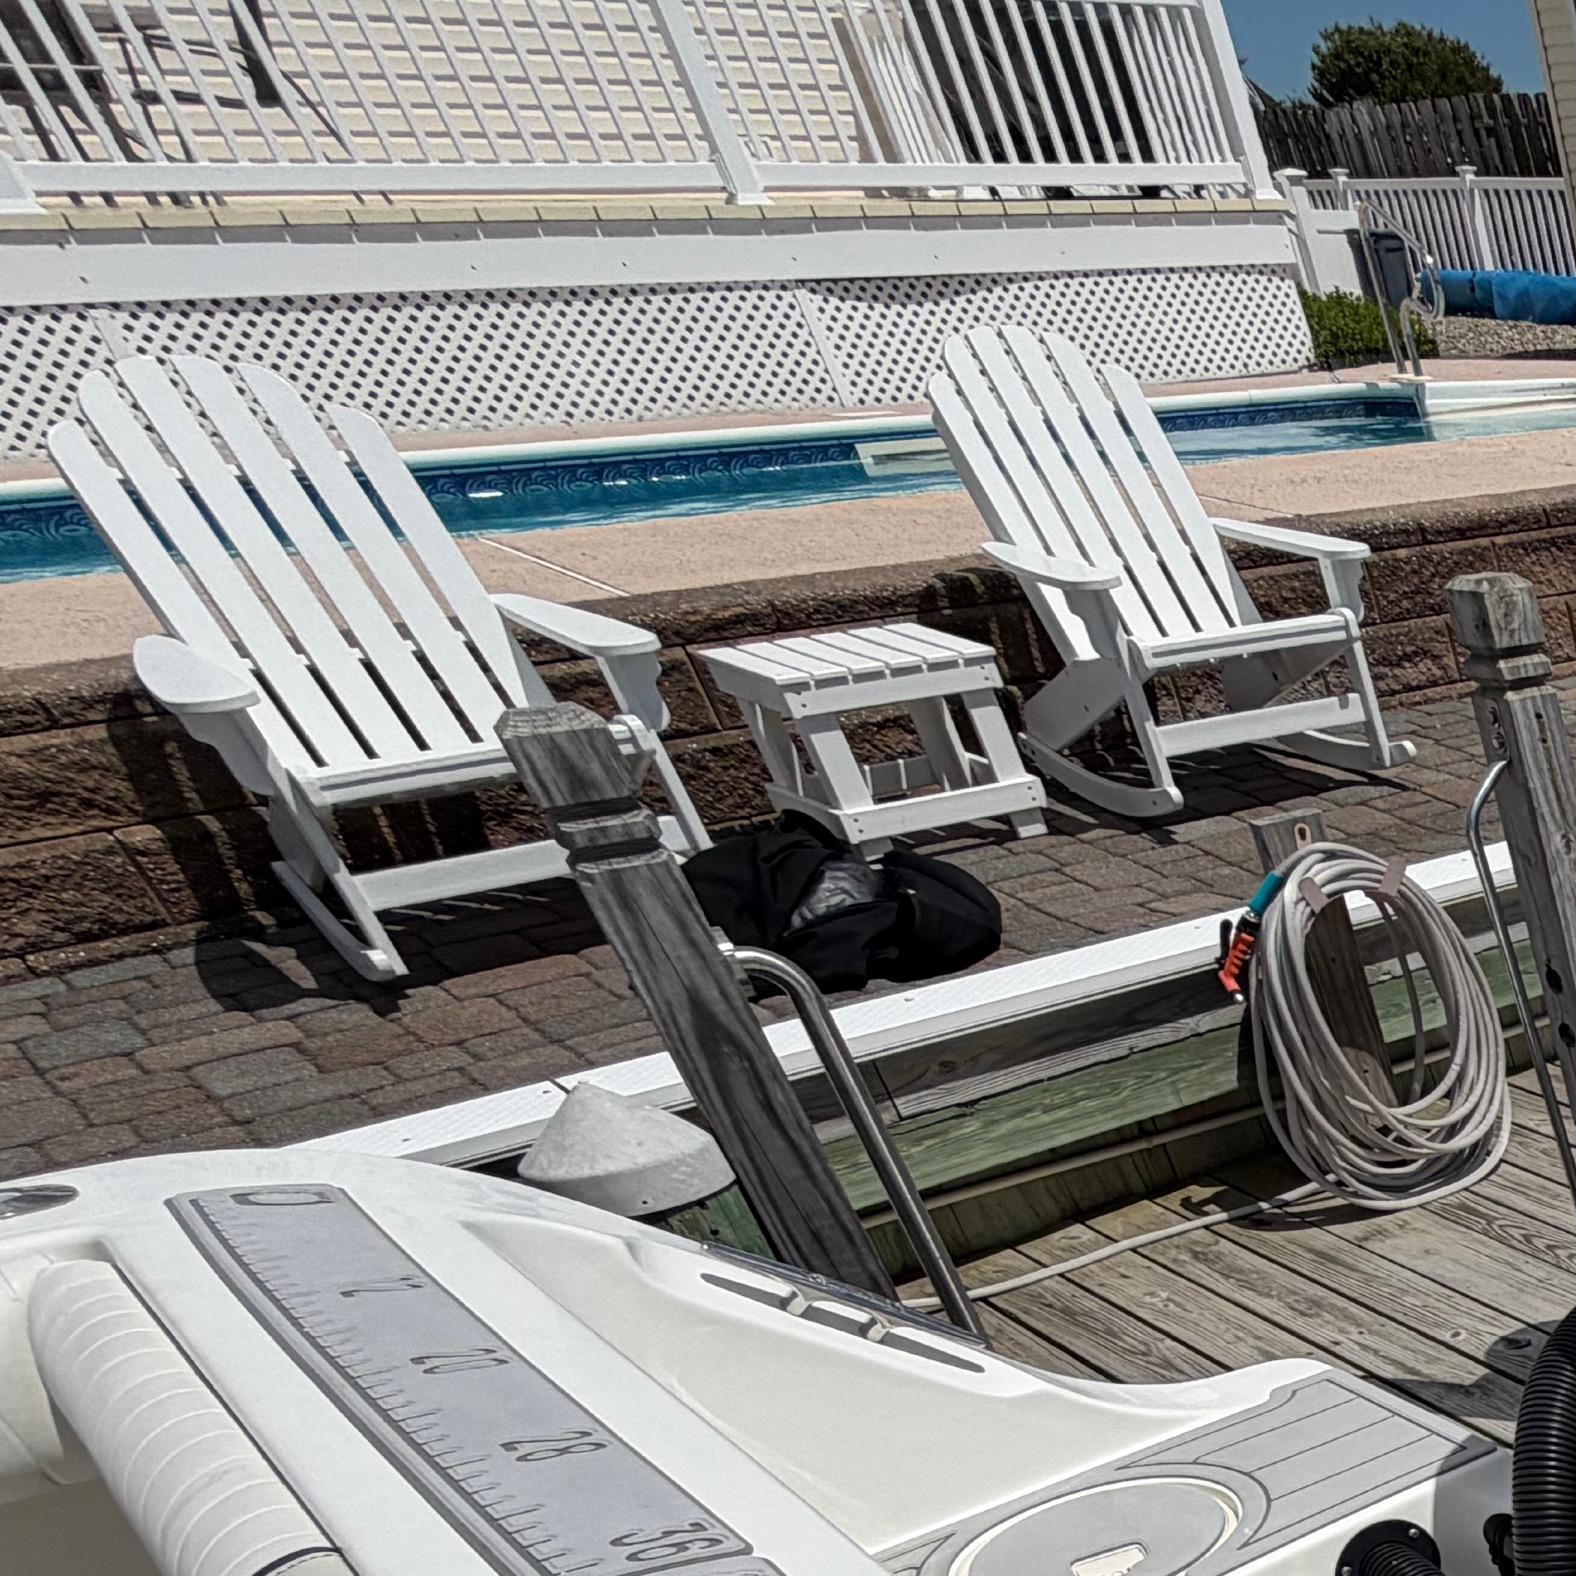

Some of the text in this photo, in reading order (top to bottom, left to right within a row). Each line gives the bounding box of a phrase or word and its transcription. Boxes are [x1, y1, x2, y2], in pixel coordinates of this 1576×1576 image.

[409, 1347, 510, 1375] 20
[498, 1430, 608, 1463] 28
[608, 1521, 724, 1563] 36
